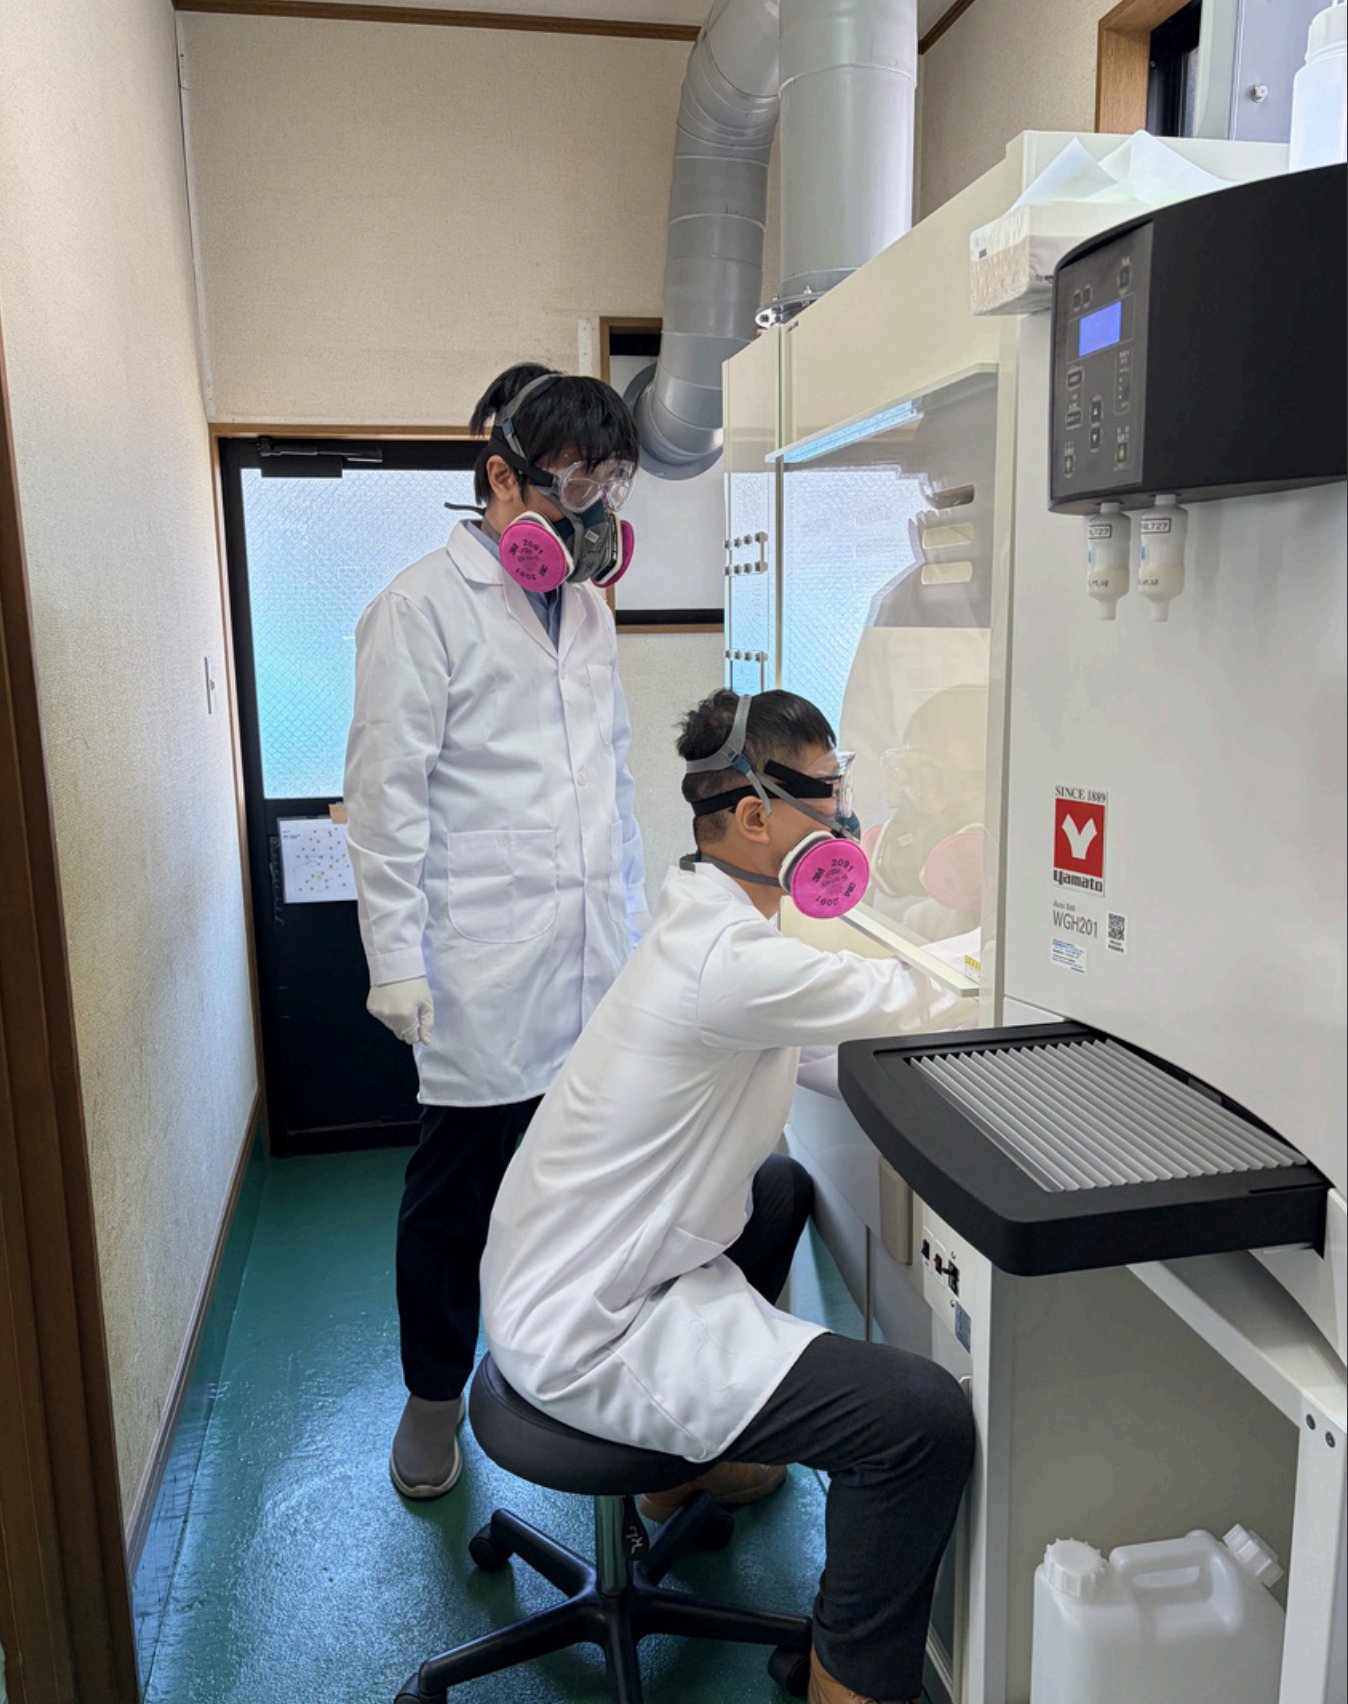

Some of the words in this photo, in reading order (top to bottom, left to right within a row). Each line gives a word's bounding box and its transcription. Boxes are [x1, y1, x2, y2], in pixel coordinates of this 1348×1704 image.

[522, 539, 544, 555] 2091
[1055, 785, 1085, 800] SINCE
[831, 858, 854, 872] 2091
[1052, 910, 1098, 938] WGH201
